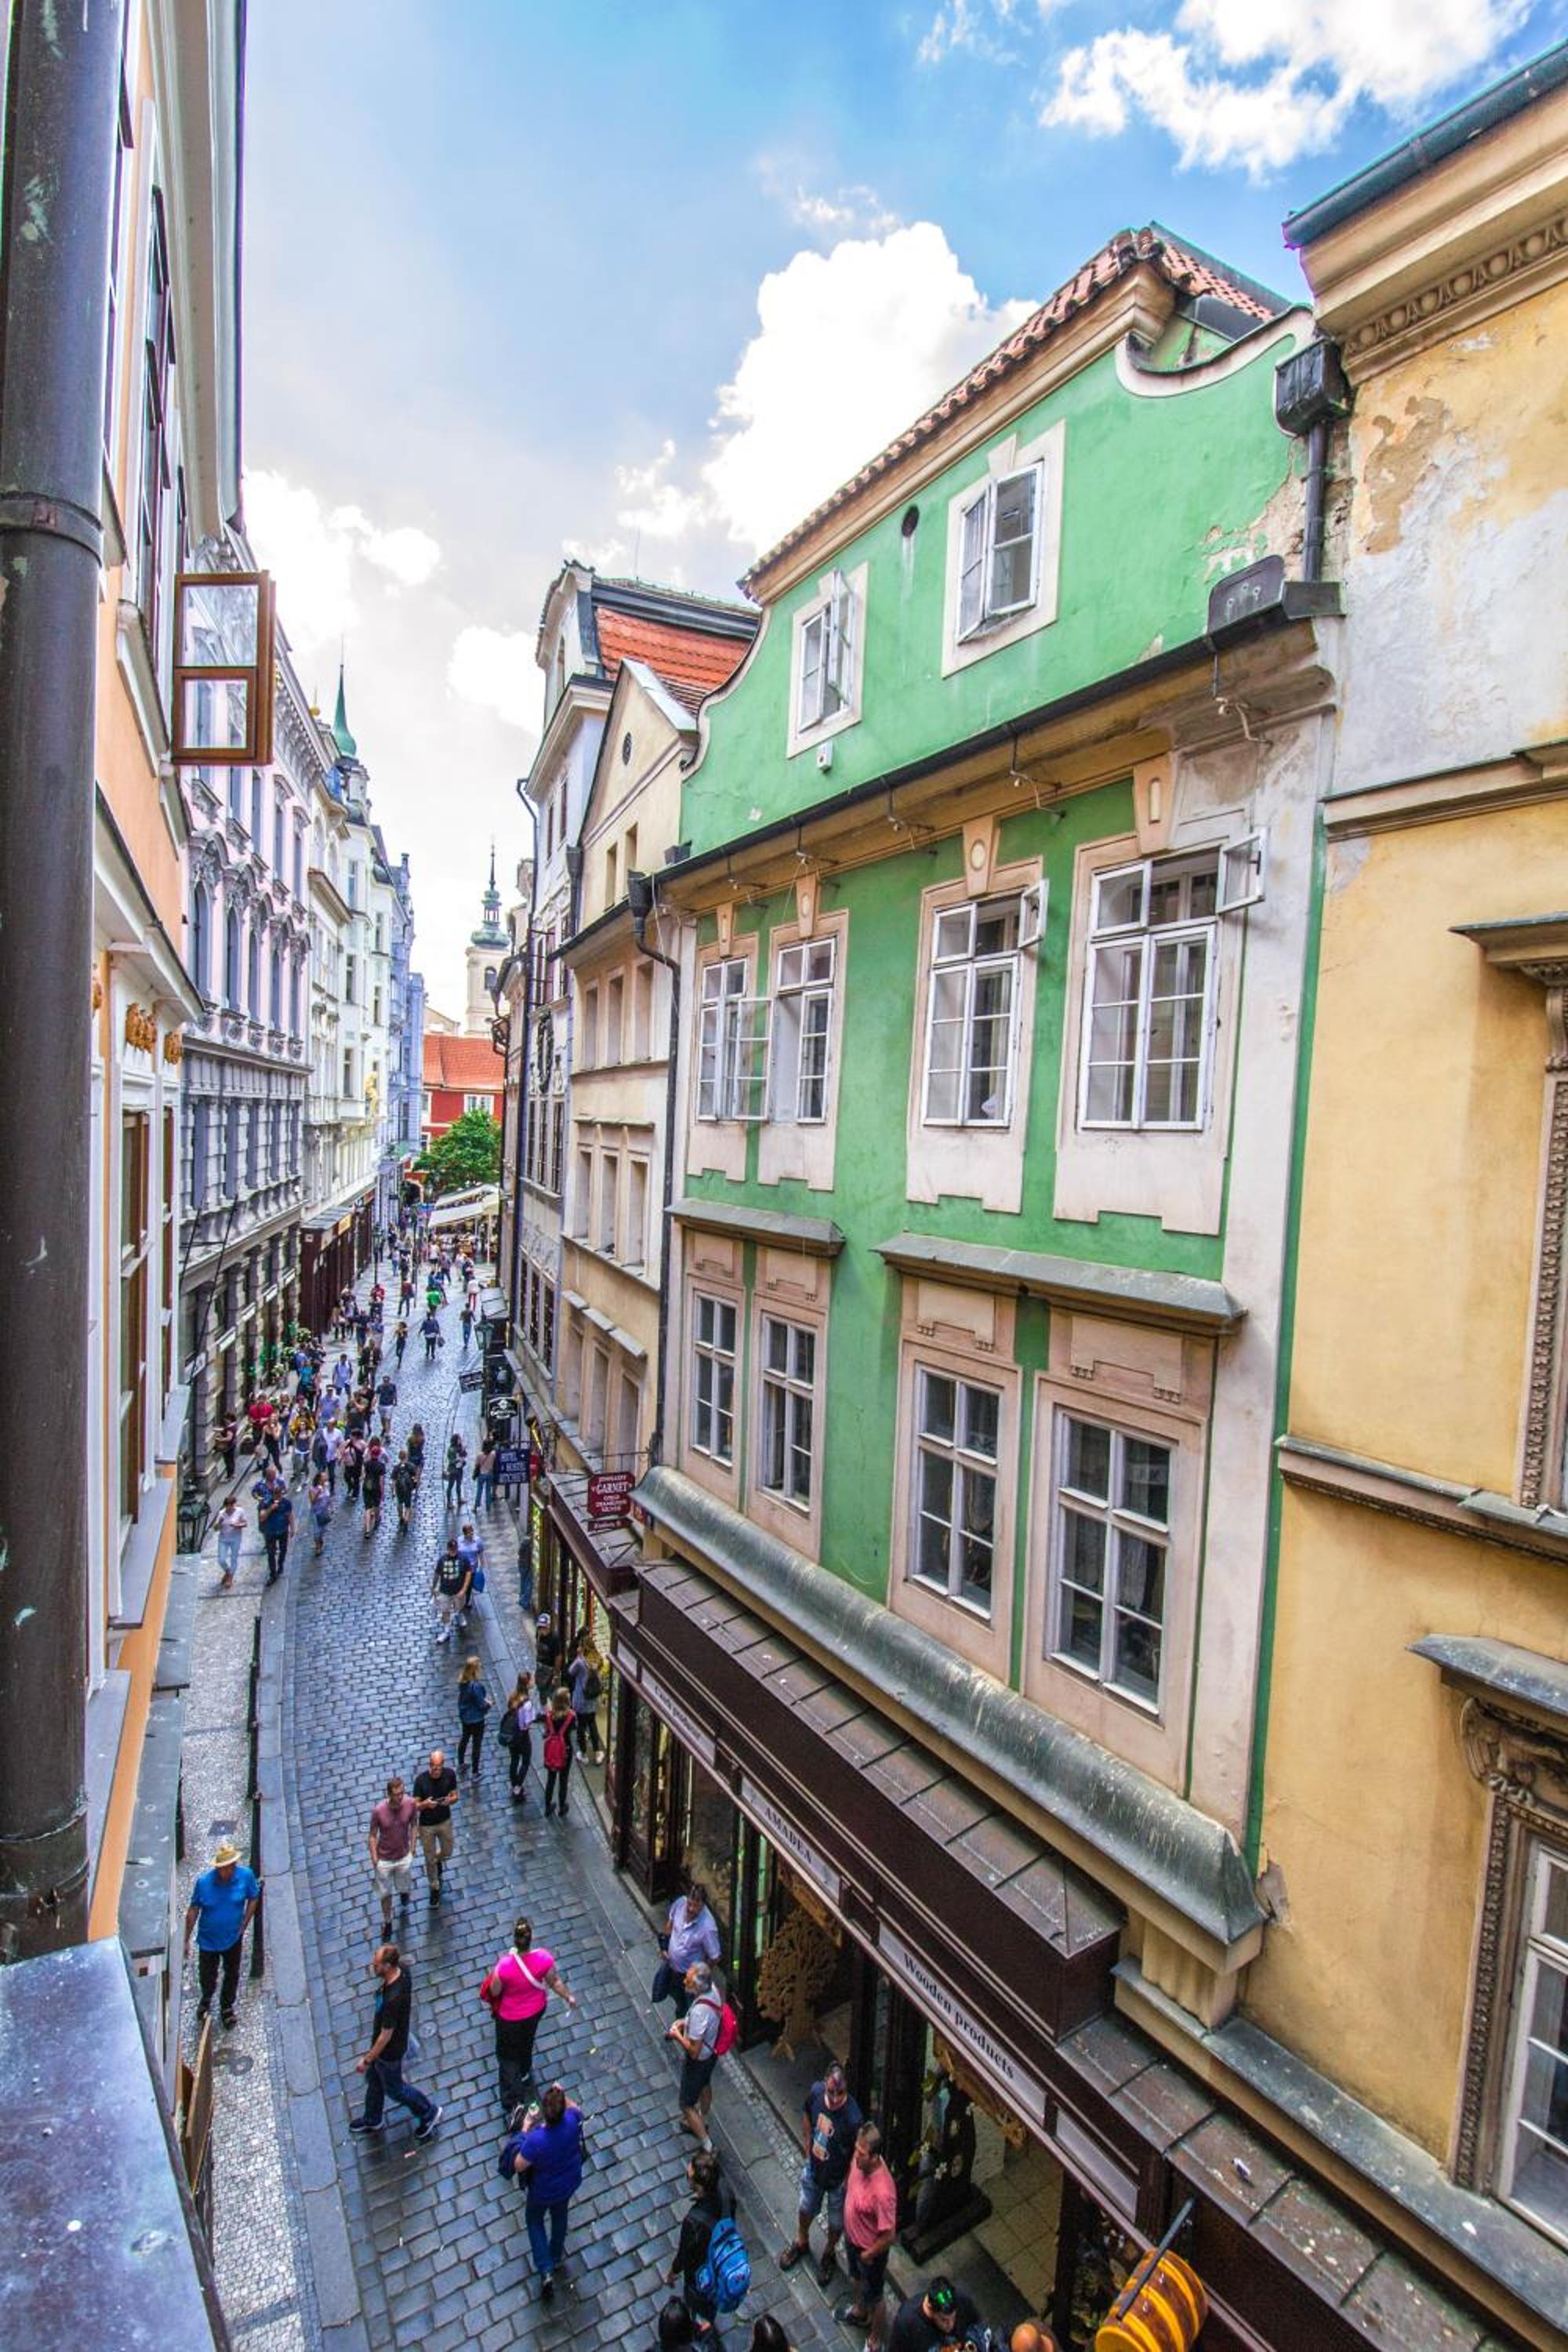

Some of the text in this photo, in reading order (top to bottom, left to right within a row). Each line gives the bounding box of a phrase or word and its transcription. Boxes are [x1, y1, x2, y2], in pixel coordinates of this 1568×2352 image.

[597, 1481, 628, 1494] GARNET
[765, 1806, 811, 1864] AMADEA
[903, 1952, 1014, 2079] Wooden products
